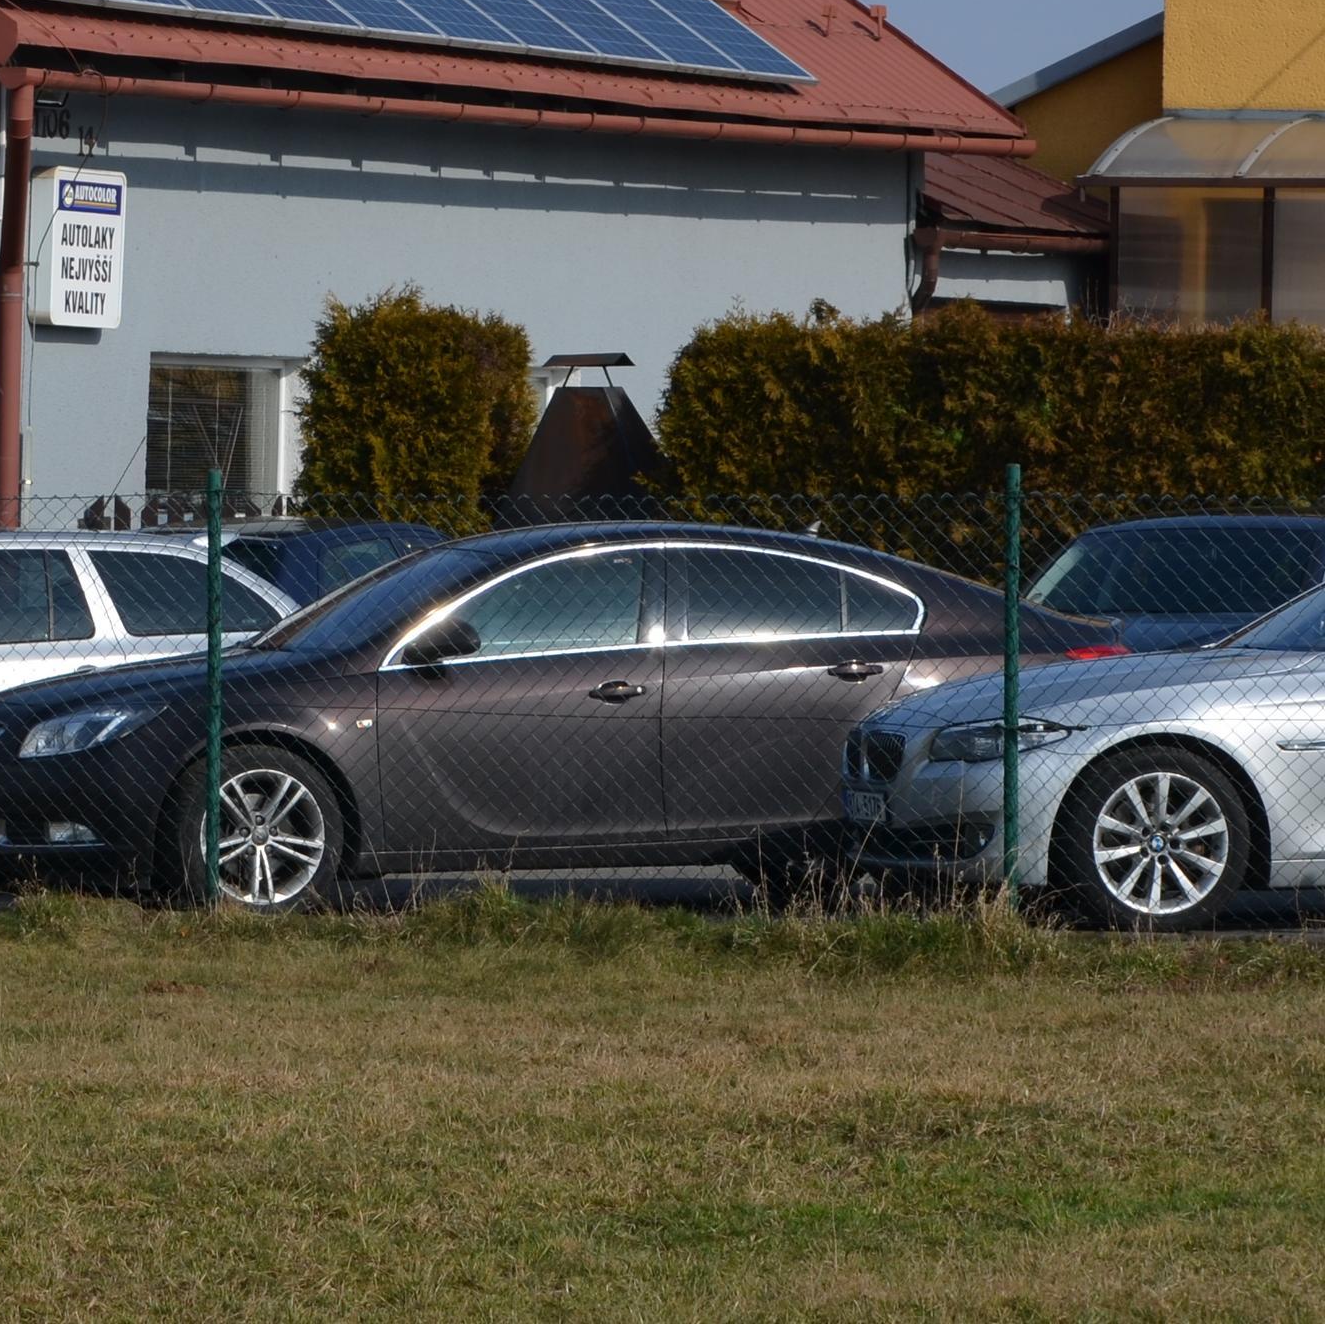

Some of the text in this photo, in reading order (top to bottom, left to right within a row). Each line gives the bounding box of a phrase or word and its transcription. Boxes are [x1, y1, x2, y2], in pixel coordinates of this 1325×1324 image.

[75, 184, 117, 203] AUTOCOLOR
[61, 223, 115, 250] AUTOLAKY
[61, 255, 112, 283] NEJVYŠŠÍ
[64, 290, 106, 315] KVALITY
